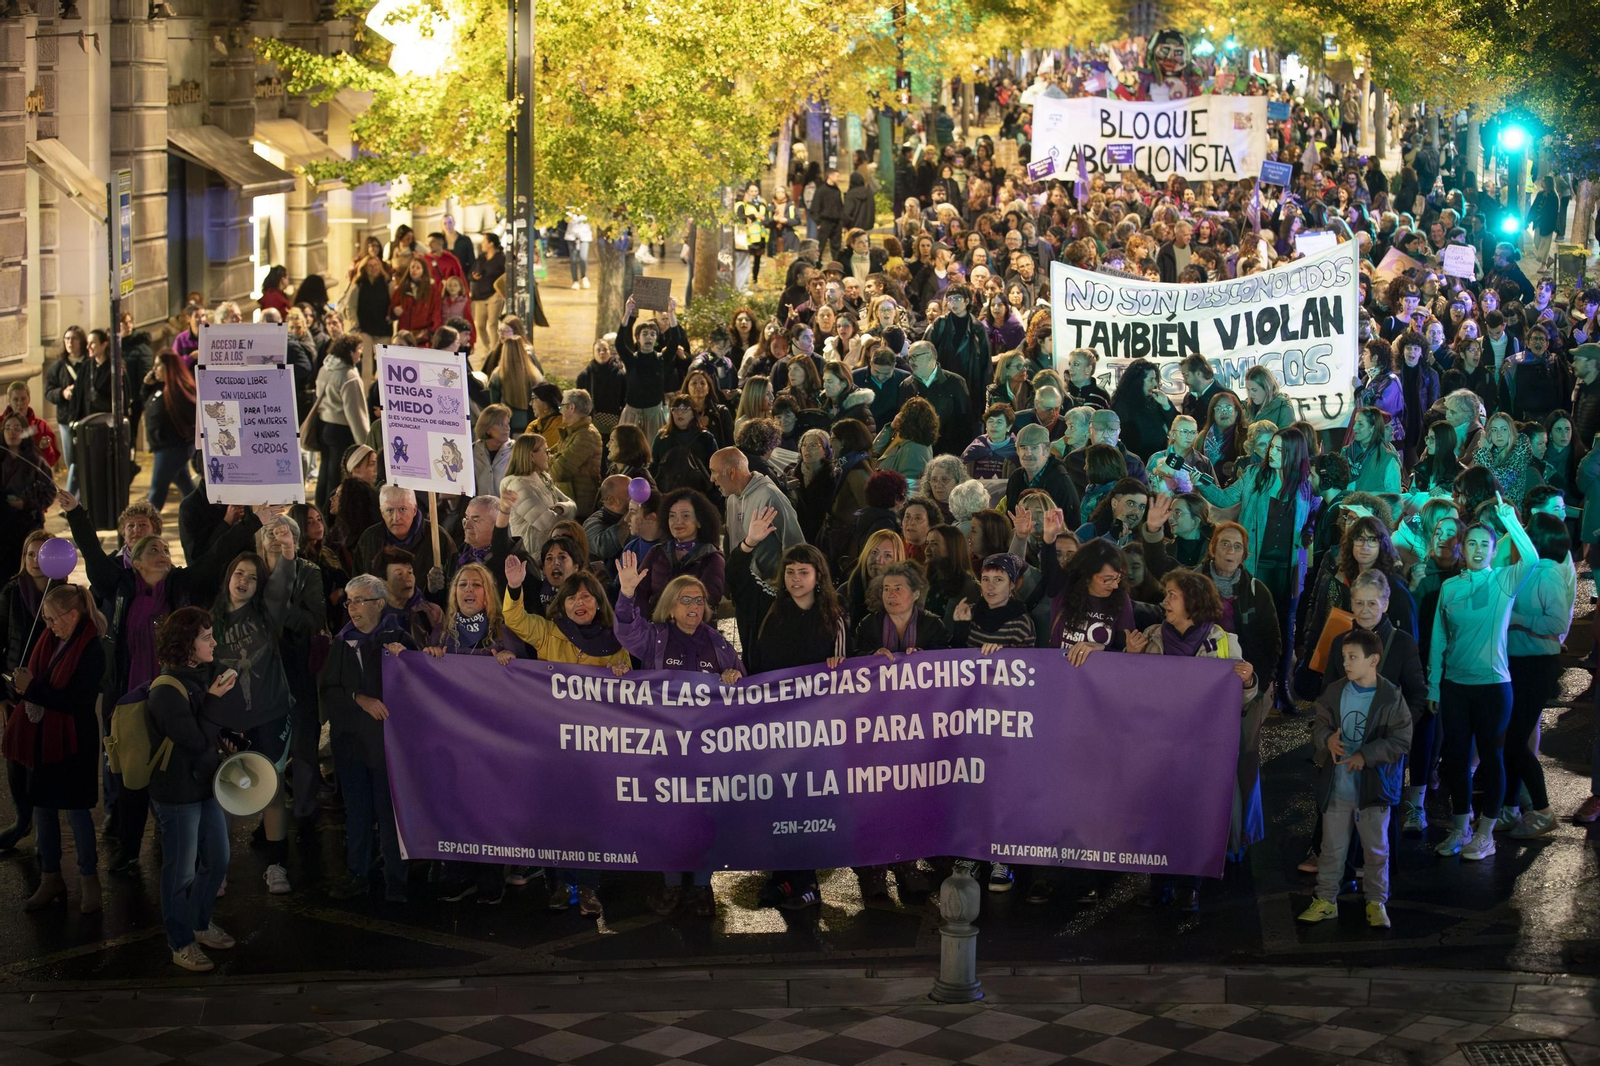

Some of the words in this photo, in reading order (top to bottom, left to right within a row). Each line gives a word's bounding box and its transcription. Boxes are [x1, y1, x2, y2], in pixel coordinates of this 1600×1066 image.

[1100, 108, 1208, 139] BLOQUE
[1065, 143, 1237, 174] ABOCIONISTA
[1065, 277, 1114, 311] NO
[1117, 287, 1179, 315] SON
[1184, 256, 1354, 311] DESCONOCIDOS
[1066, 312, 1200, 359] TAMBIÉN
[1213, 295, 1344, 350] VIOLAN
[211, 340, 237, 350] ACCESO
[211, 352, 222, 362] LSE
[224, 352, 229, 361] A
[231, 352, 244, 362] LOS
[247, 376, 268, 386] LIBRE
[388, 364, 418, 384] NO
[221, 391, 232, 400] SIN
[233, 391, 268, 400] VIOLENCIA
[386, 384, 433, 398] TENGAS
[388, 400, 434, 416] MIEDO
[244, 418, 256, 426] LAS
[401, 416, 429, 424] VIOLENCIA
[251, 442, 289, 454] SORDAS
[551, 673, 654, 706] CONTRA
[662, 680, 711, 706] LAS
[718, 667, 872, 706] VIOLENCIAS
[880, 659, 1036, 692] MACHISTAS:
[560, 724, 668, 756] FIRMEZA
[676, 730, 692, 756] Y
[700, 718, 848, 754] SORORIDAD
[856, 713, 924, 744] PARA
[932, 708, 1034, 738] ROMPER
[616, 776, 648, 802] EL
[655, 774, 774, 804] SILENCIO
[782, 772, 798, 798] Y
[807, 770, 840, 797] LA
[847, 757, 986, 794] IMPUNIDAD
[772, 818, 836, 835] 25N-2024
[438, 841, 479, 855] ESPACIO
[482, 844, 535, 859] FEMINISMO
[538, 849, 586, 862] UNITARIO
[588, 852, 601, 863] DE
[604, 851, 638, 864] GRANÁ
[990, 843, 1059, 859] PLATAFORMA
[1061, 848, 1100, 862] 8M/25N
[1102, 851, 1116, 863] DE
[1118, 852, 1168, 866] GRANADA
